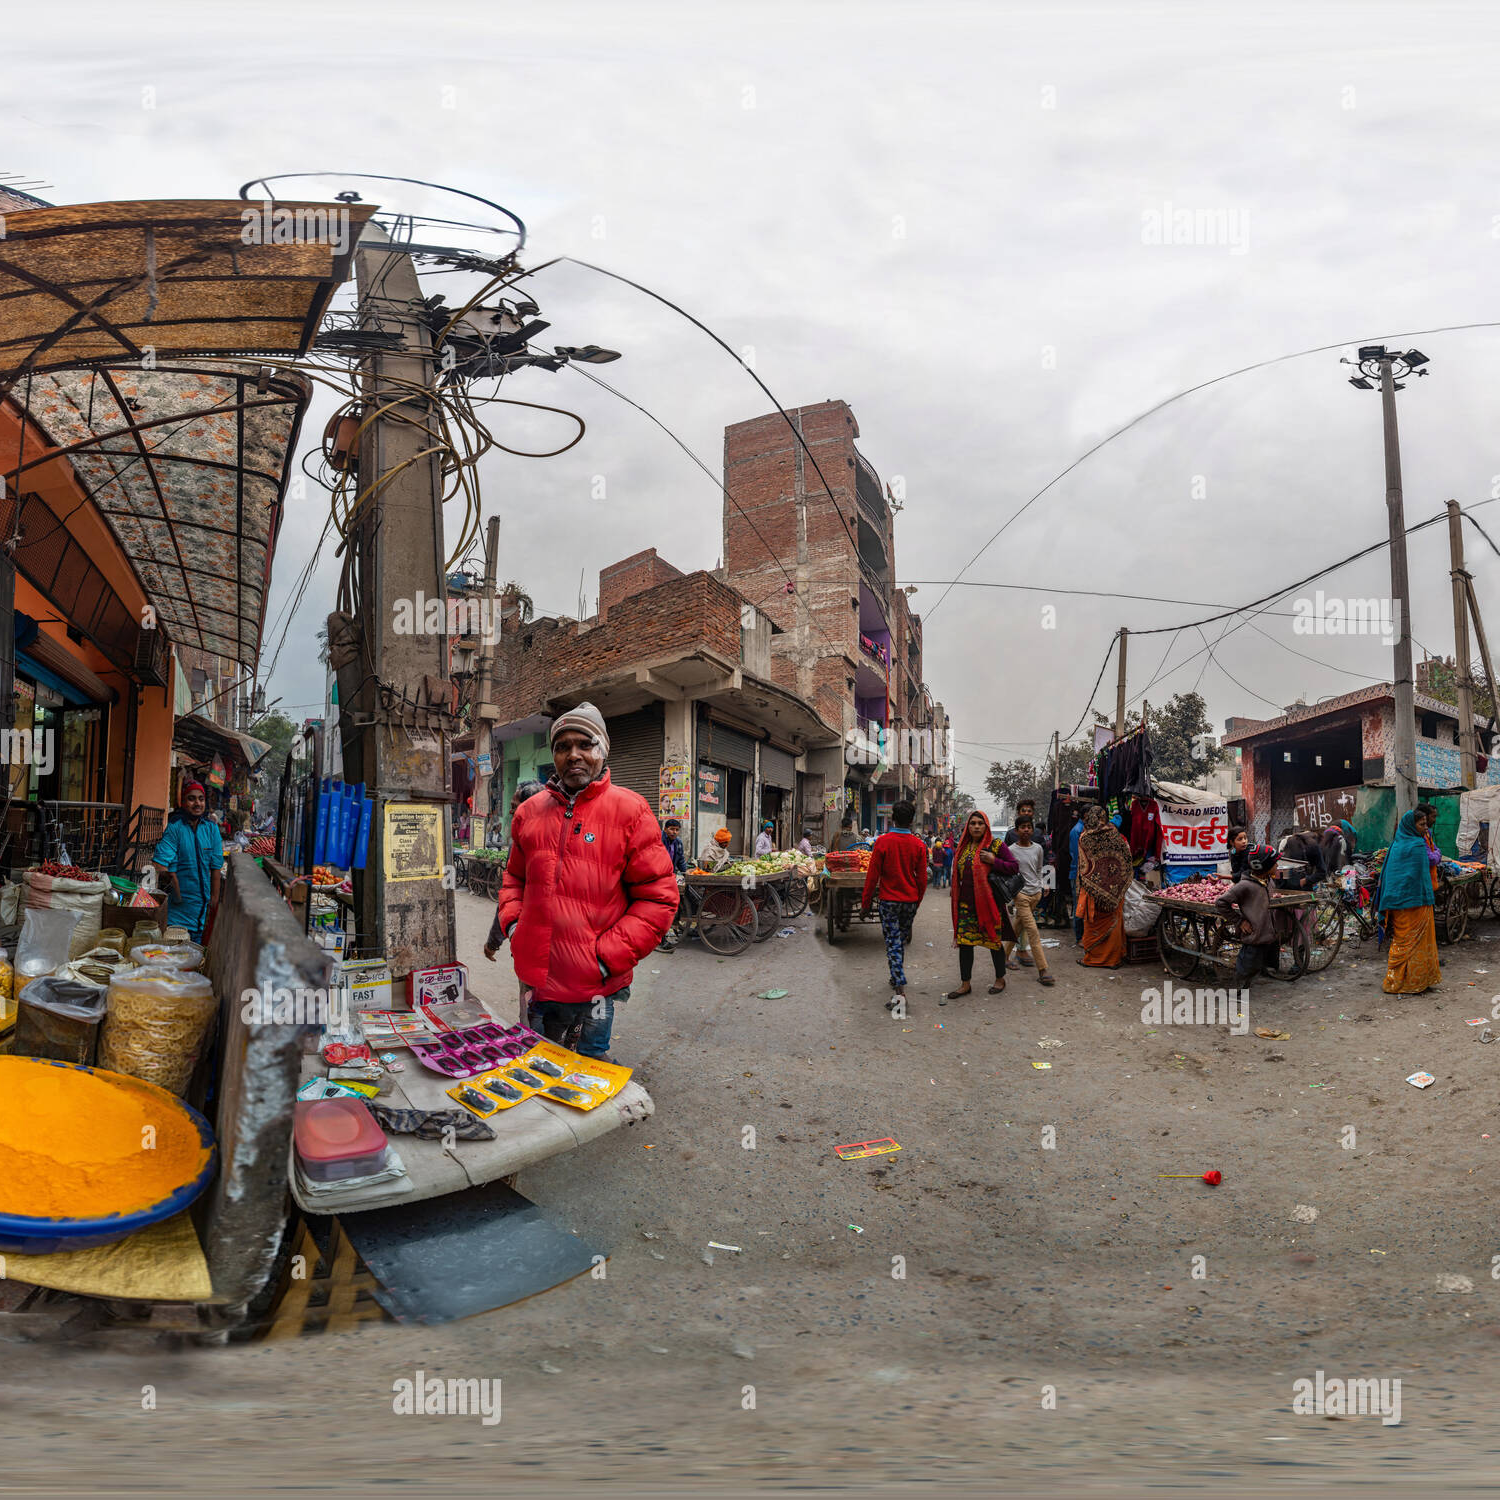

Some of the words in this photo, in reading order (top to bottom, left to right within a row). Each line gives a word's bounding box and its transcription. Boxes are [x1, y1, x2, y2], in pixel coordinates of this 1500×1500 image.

[1161, 804, 1202, 817] AL-ASAD
[1203, 806, 1228, 816] MEDIC
[352, 989, 375, 1001] FAST
